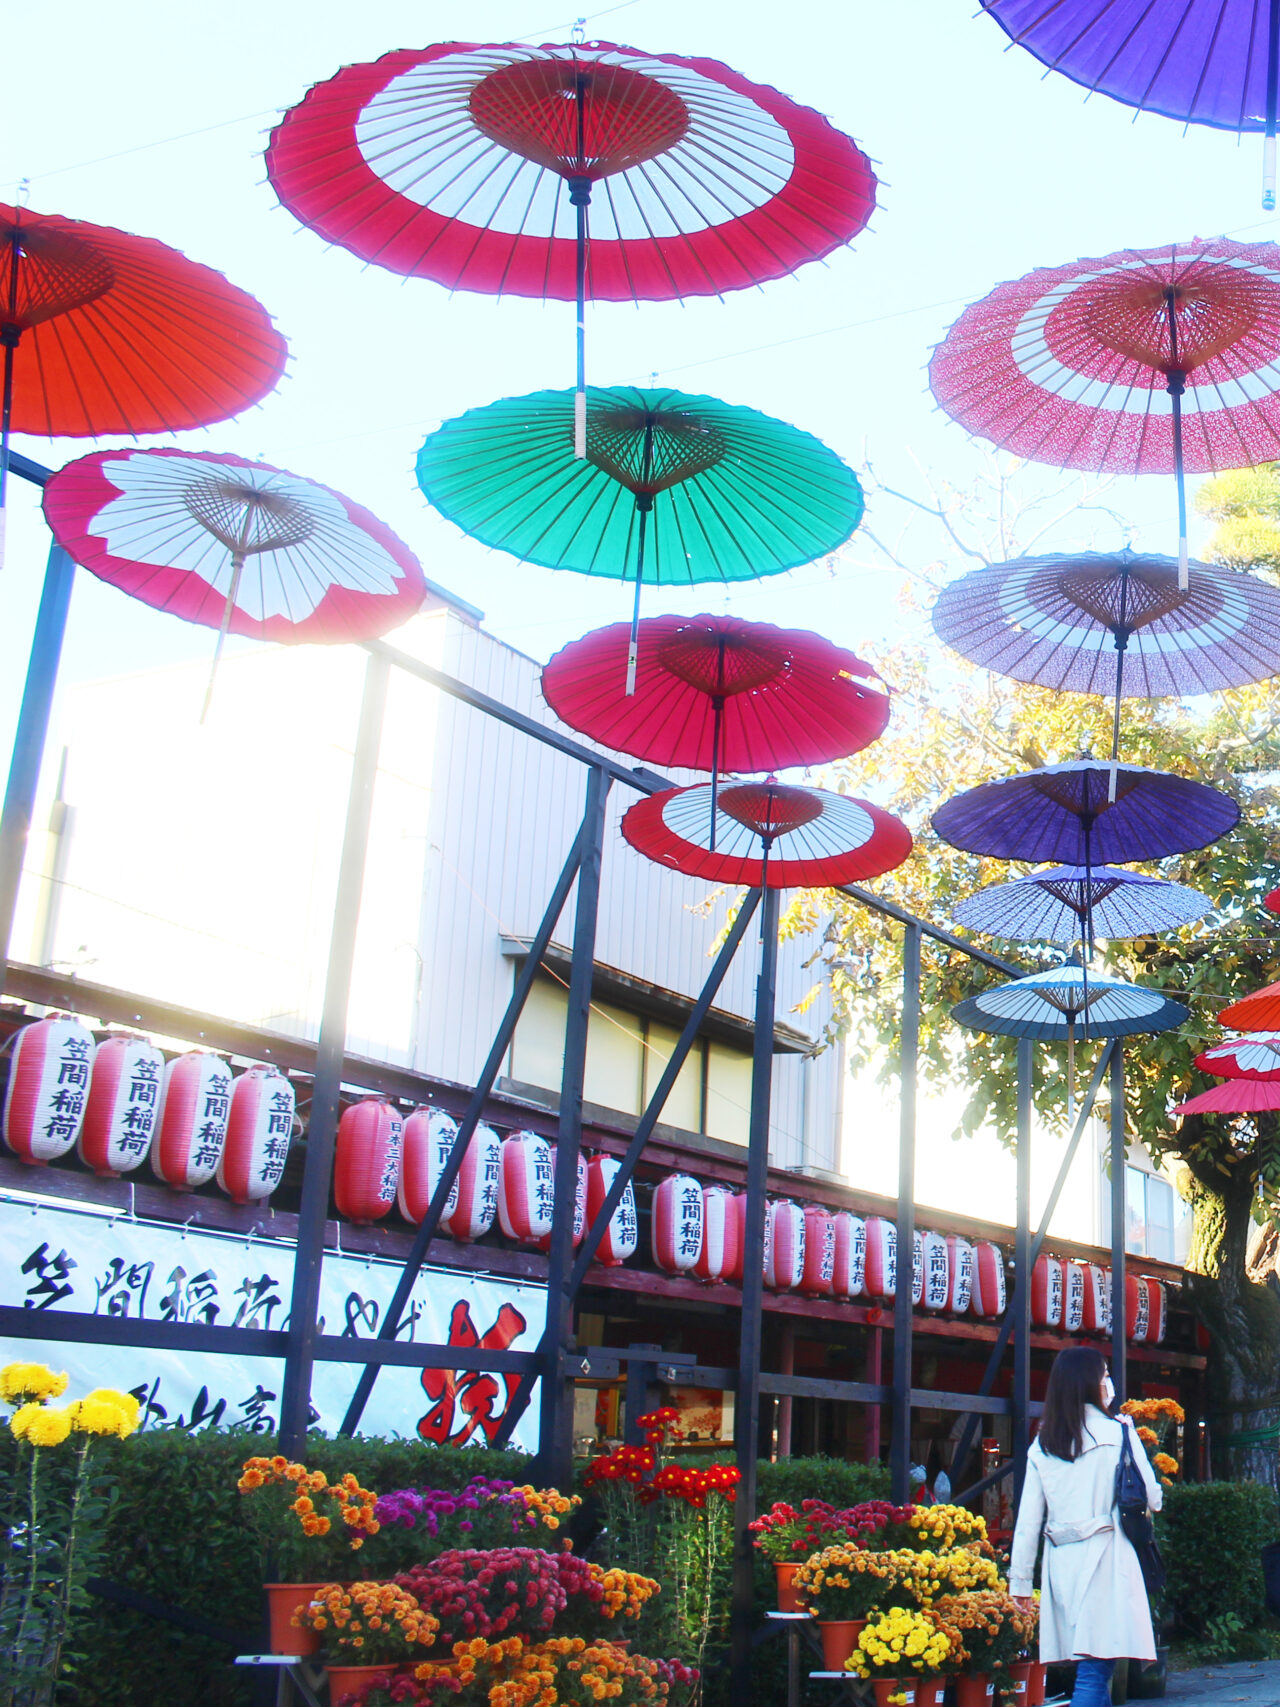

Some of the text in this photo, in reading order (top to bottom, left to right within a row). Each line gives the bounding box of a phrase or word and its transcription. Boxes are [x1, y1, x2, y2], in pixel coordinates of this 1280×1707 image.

[43, 1037, 90, 1142] 笠間稲荷
[115, 1058, 160, 1157] 笠間稲荷
[191, 1073, 230, 1170] 笠間稲荷
[259, 1091, 292, 1184] 笠間稲荷
[378, 1121, 402, 1202] 日本三大稲荷
[479, 1144, 501, 1224] 笠間稲荷
[533, 1146, 555, 1222] 笠間稲荷
[678, 1187, 701, 1257] 笠間稲荷
[928, 1245, 947, 1303] 笠間稲荷
[957, 1250, 973, 1308] 笠間稲荷
[1068, 1273, 1083, 1326] 笠間稲荷
